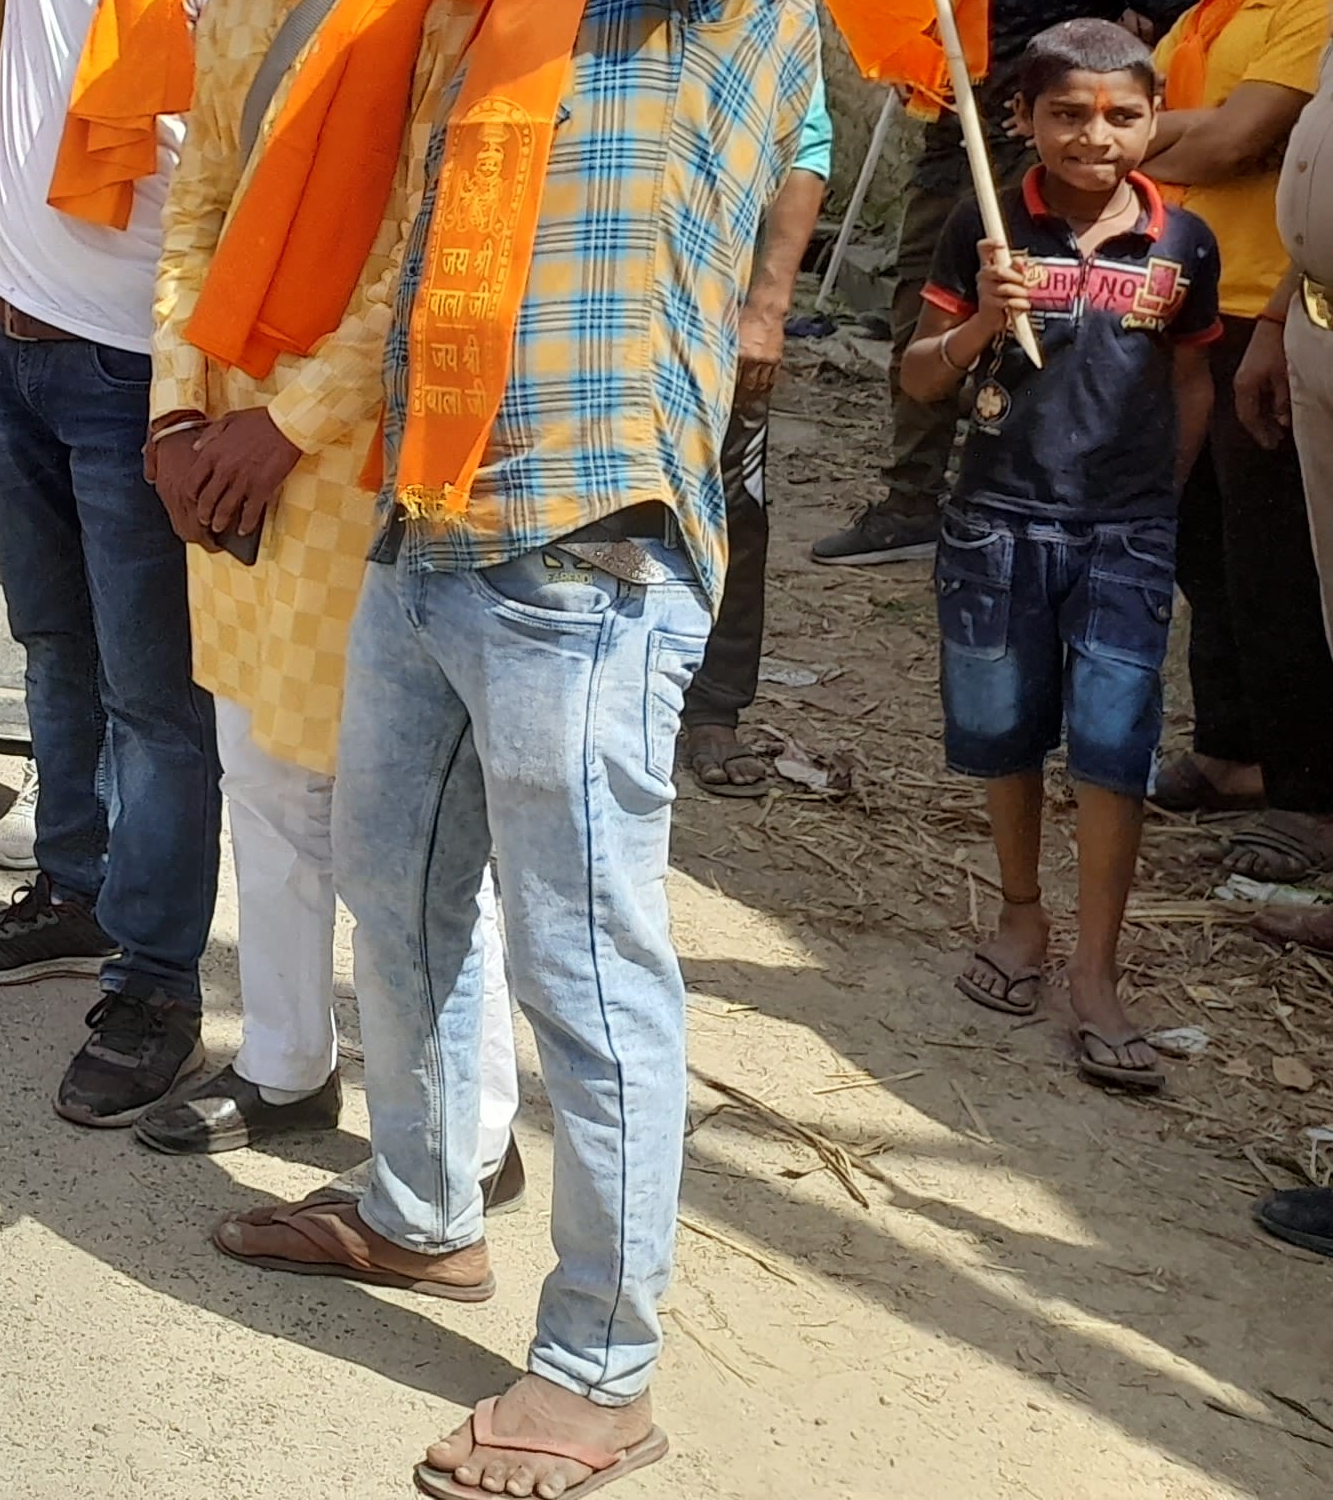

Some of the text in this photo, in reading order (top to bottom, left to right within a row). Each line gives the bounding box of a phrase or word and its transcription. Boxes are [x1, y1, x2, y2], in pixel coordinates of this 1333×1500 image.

[442, 239, 493, 278] जय श्री
[429, 280, 490, 320] बाला जी
[431, 334, 481, 376] जय श्री
[422, 378, 487, 417] बाला जी
